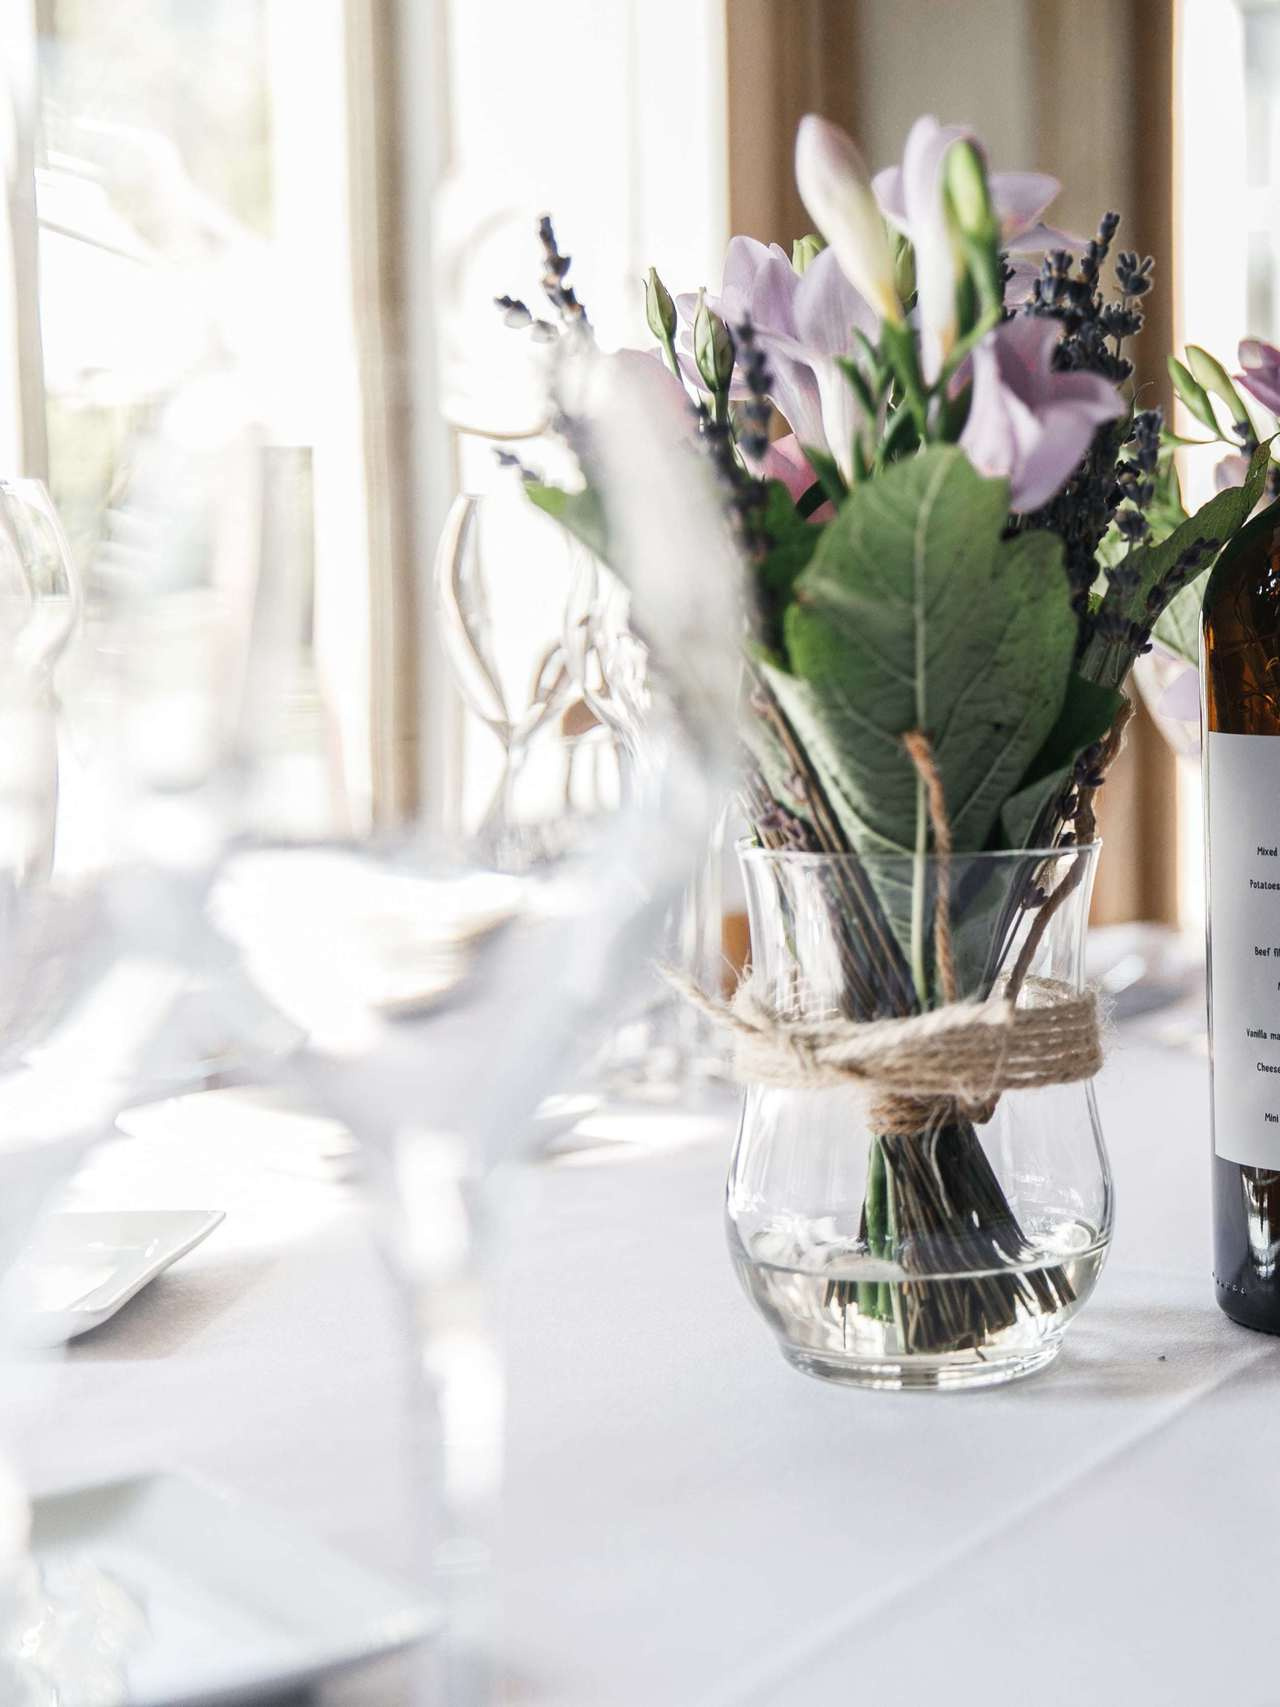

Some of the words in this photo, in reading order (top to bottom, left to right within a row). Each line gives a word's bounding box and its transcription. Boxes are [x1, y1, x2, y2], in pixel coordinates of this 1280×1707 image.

[1257, 846, 1278, 857] Mixed
[1249, 879, 1280, 891] Potatoes
[1254, 946, 1271, 957] Beef
[1246, 1028, 1268, 1040] Vanilla
[1264, 1113, 1279, 1123] Mini
